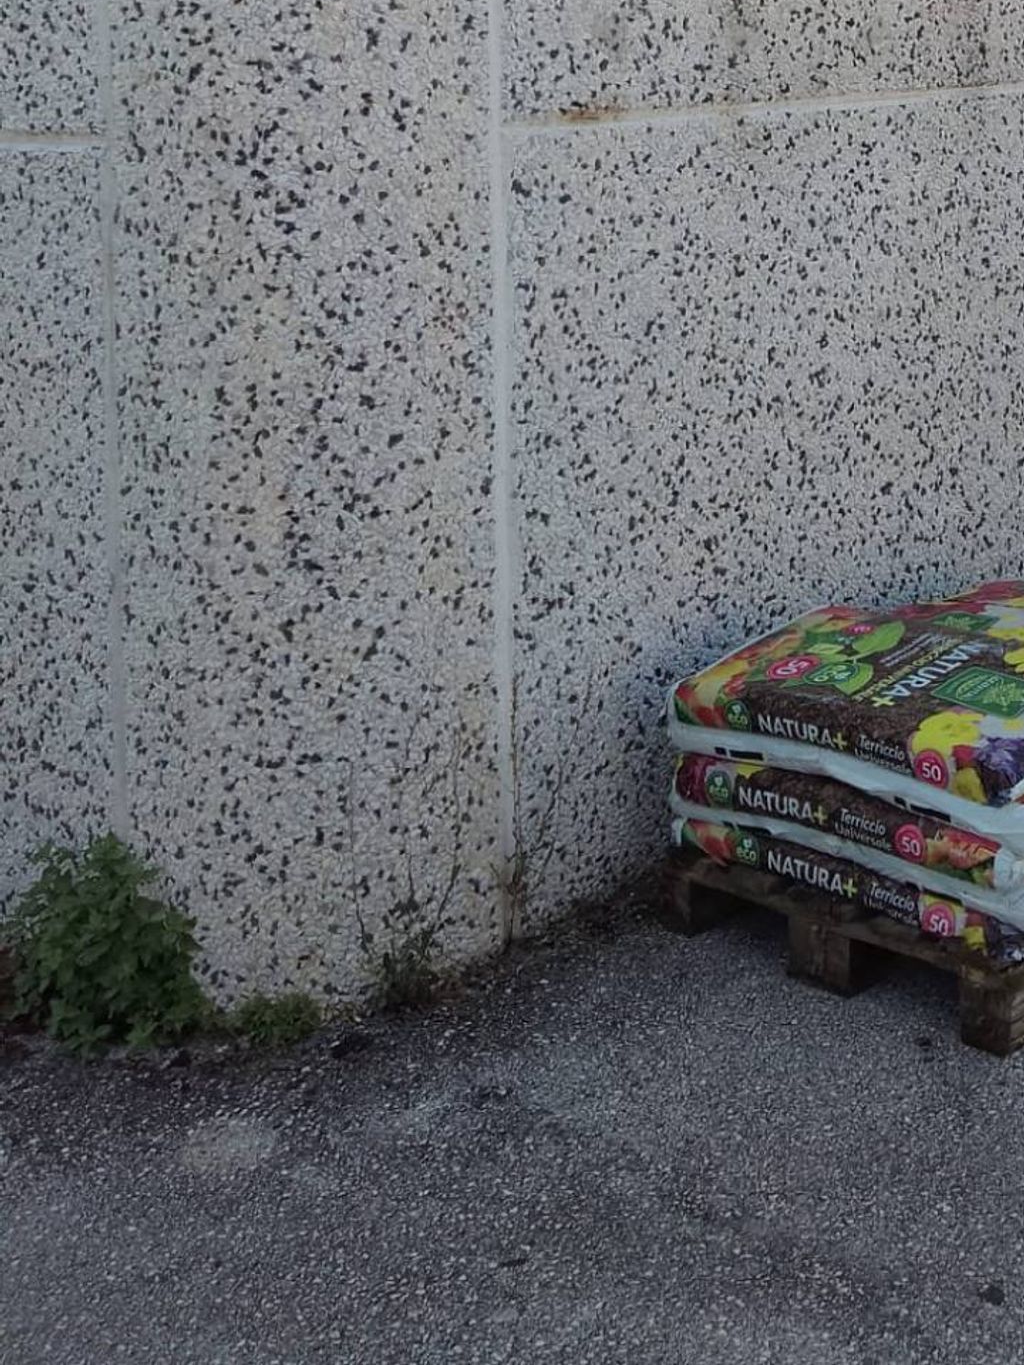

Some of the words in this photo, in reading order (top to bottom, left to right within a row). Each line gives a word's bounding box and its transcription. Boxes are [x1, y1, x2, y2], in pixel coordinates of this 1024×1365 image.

[758, 713, 848, 751] NATURA+
[859, 734, 906, 762] Terriccio
[922, 762, 942, 782] 50
[738, 786, 828, 826] NATURA+
[840, 807, 886, 836] Terriccio
[901, 836, 921, 856] 50
[767, 850, 859, 898] NATURA+
[870, 882, 915, 912] Terriccio
[929, 914, 949, 936] 50
